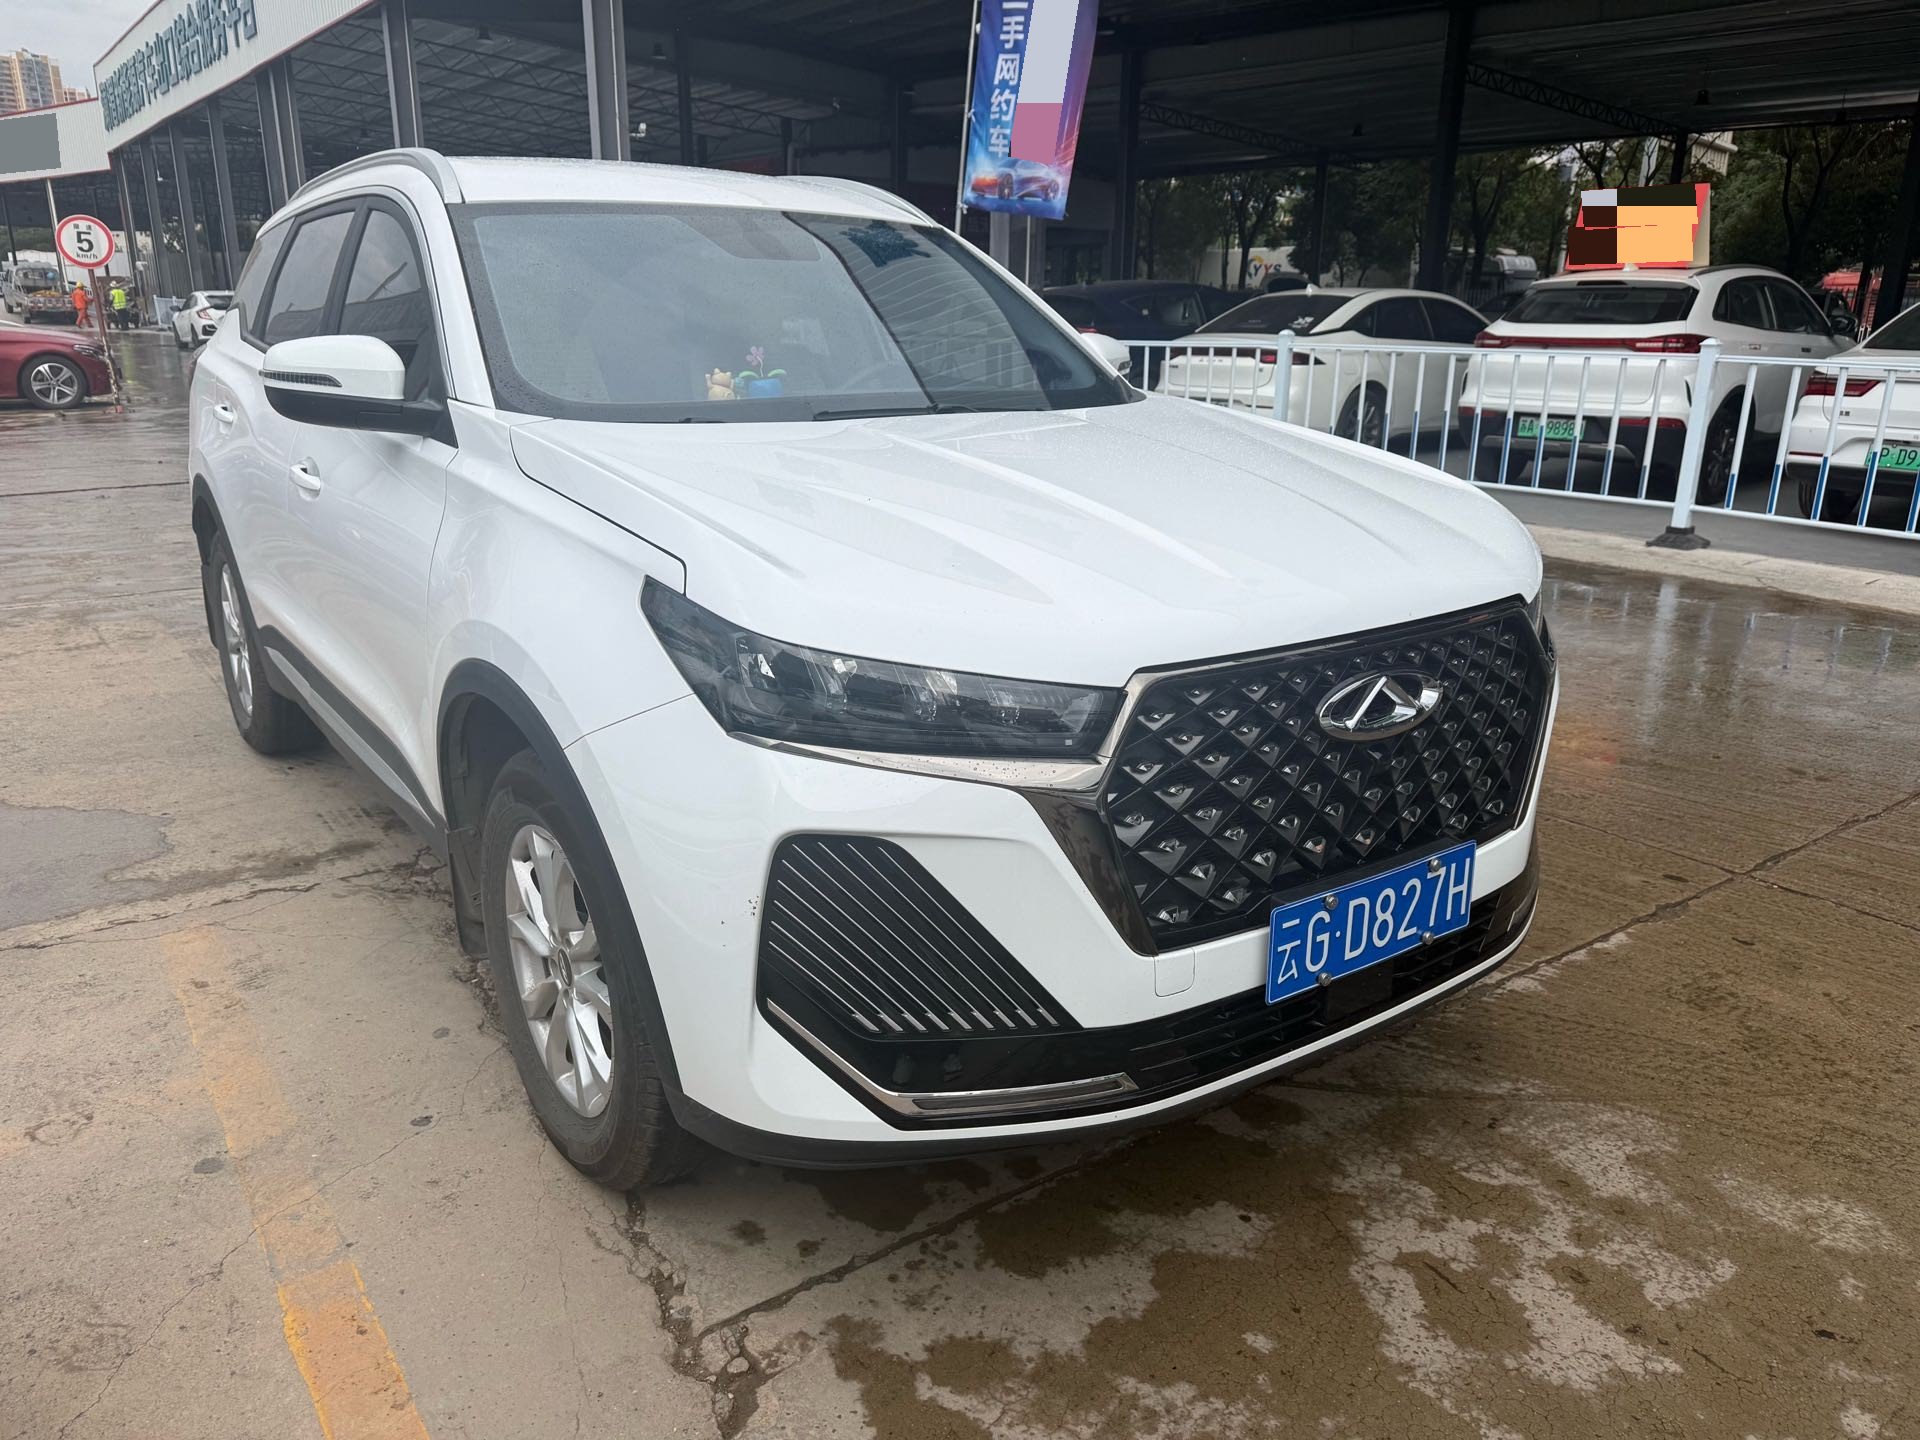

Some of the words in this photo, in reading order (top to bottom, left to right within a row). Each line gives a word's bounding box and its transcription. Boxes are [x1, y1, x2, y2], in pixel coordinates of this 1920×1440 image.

[76, 230, 94, 253] 5
[76, 252, 98, 260] km/h
[1278, 857, 1471, 985] 云G·D827H
